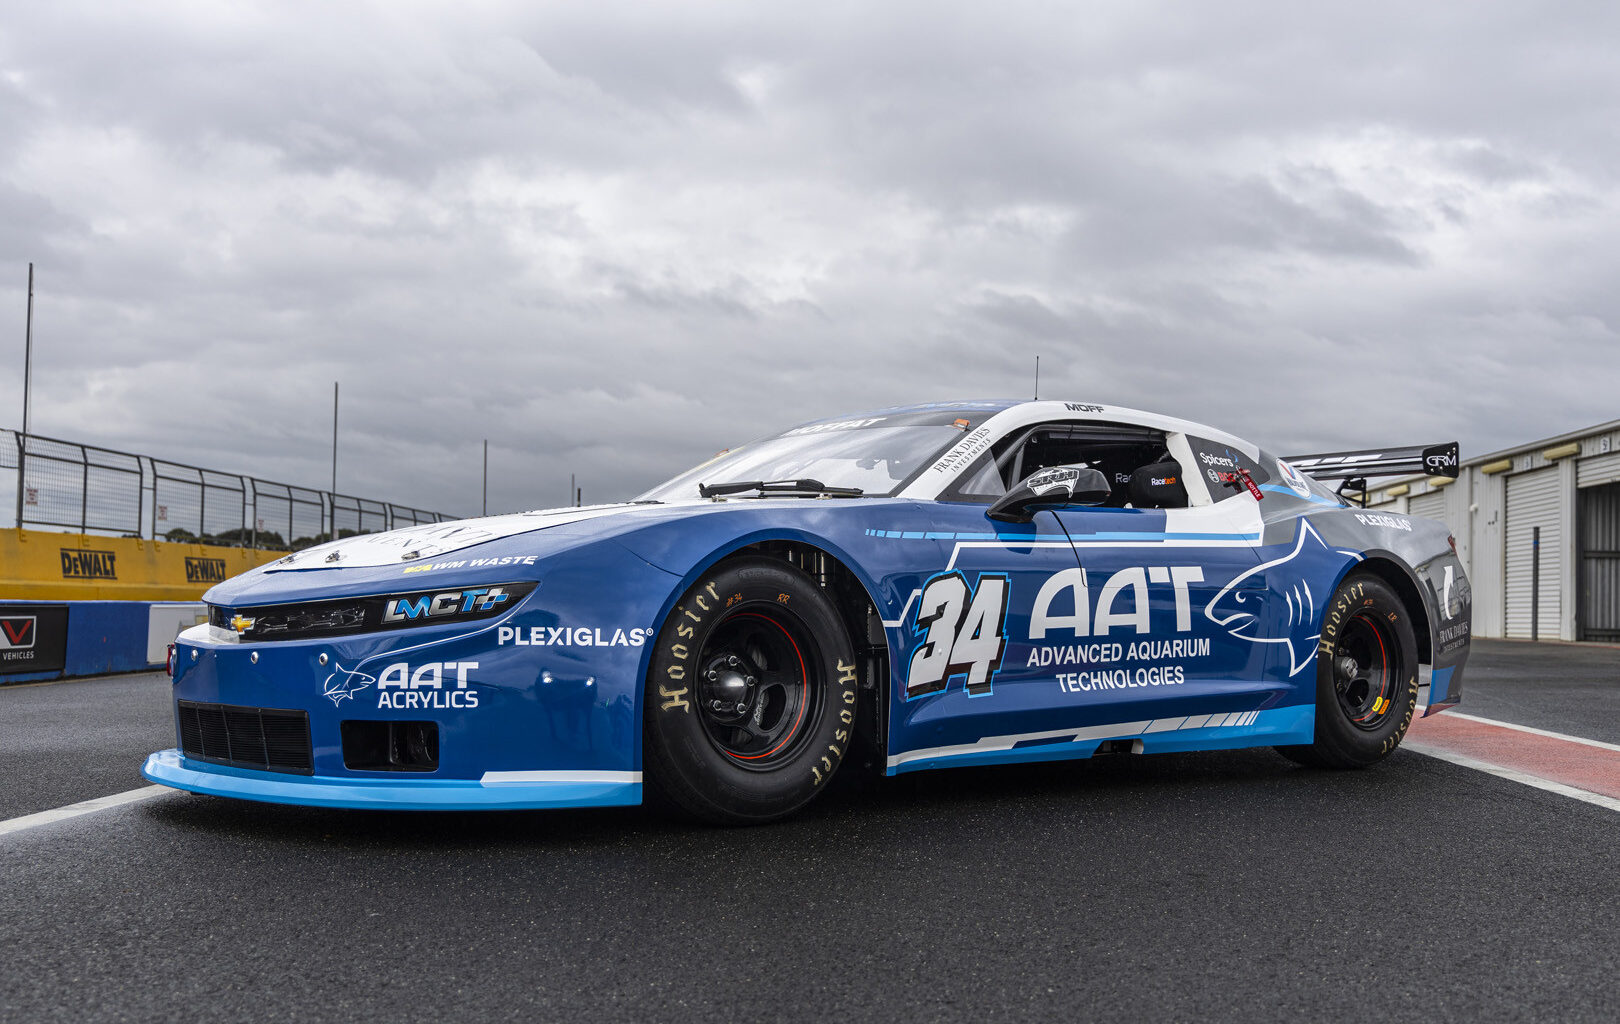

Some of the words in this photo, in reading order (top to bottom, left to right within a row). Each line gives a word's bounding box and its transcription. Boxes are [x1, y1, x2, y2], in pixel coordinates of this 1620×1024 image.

[1063, 402, 1105, 413] MOFF
[934, 448, 965, 472] FRANK
[961, 427, 990, 451] DAVIES
[951, 439, 991, 473] INVESTMENTS
[1199, 452, 1234, 467] Spicers
[1426, 455, 1457, 467] GRM
[1151, 476, 1177, 486] Racetech
[1247, 481, 1261, 498] BOTTLE
[469, 555, 538, 567] WASTE
[776, 592, 791, 605] RR
[1029, 566, 1205, 640] AAT
[1318, 582, 1364, 661] Hoosier
[907, 572, 1008, 696] 34
[2, 650, 35, 661] VEHICLES
[658, 581, 720, 714] Hoosier
[1026, 643, 1122, 667] ADVANCED
[1126, 638, 1210, 661] AQUARIUM
[378, 662, 479, 689] AAT
[1056, 665, 1185, 693] TECHNOLOGIES
[378, 690, 479, 708] ACRYLICS
